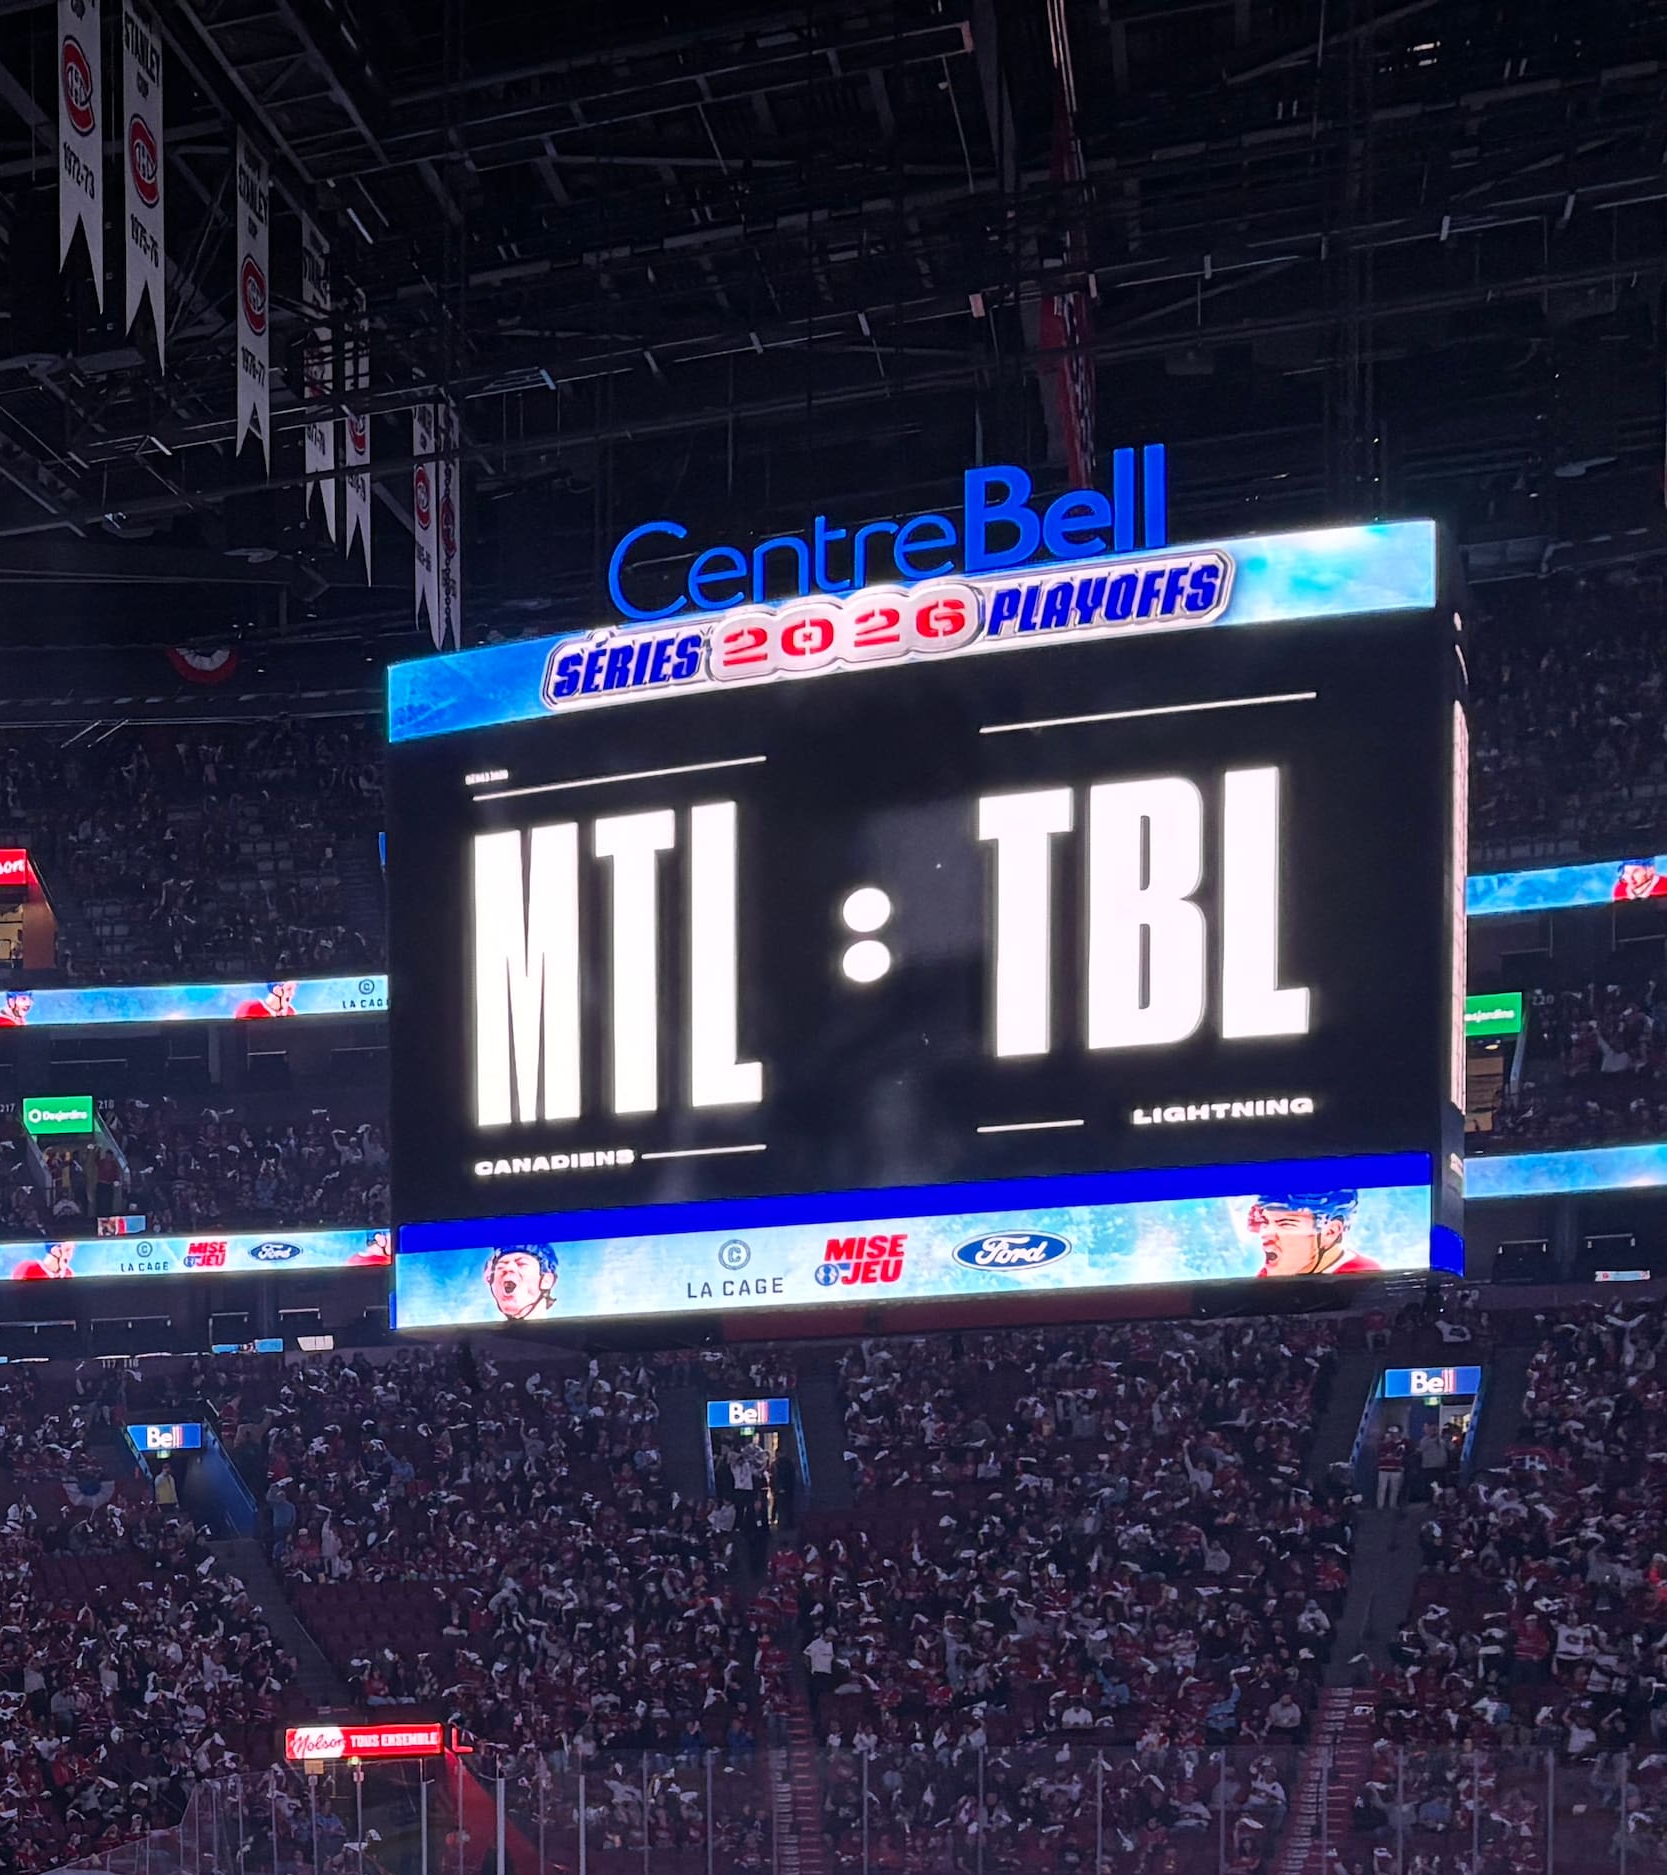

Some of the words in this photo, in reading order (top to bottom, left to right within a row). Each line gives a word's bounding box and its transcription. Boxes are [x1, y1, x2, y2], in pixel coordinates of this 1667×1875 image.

[62, 143, 95, 201] 1972-73
[553, 627, 701, 702] SÉRIES
[723, 597, 967, 669] 2026
[988, 563, 1220, 638] PLAYOFFS
[473, 800, 763, 1129] MTL
[977, 766, 1310, 1059] TBL
[42, 1110, 88, 1122] Desjardins
[1132, 1095, 1315, 1126] LIGHTNING
[473, 1147, 636, 1177] CANADIENS
[188, 1241, 227, 1256] MISE
[195, 1252, 226, 1268] JEU
[260, 1242, 293, 1259] Ford
[824, 1234, 908, 1262] MISE
[974, 1236, 1046, 1266] Ford
[121, 1262, 140, 1272] LA
[144, 1260, 169, 1272] CAGE
[841, 1258, 903, 1285] JEU
[686, 1281, 712, 1299] LA
[722, 1277, 784, 1297] CAGE
[1411, 1368, 1455, 1394] Bell
[729, 1399, 768, 1424] Bell
[147, 1425, 183, 1449] Bell
[289, 1732, 345, 1759] Molson
